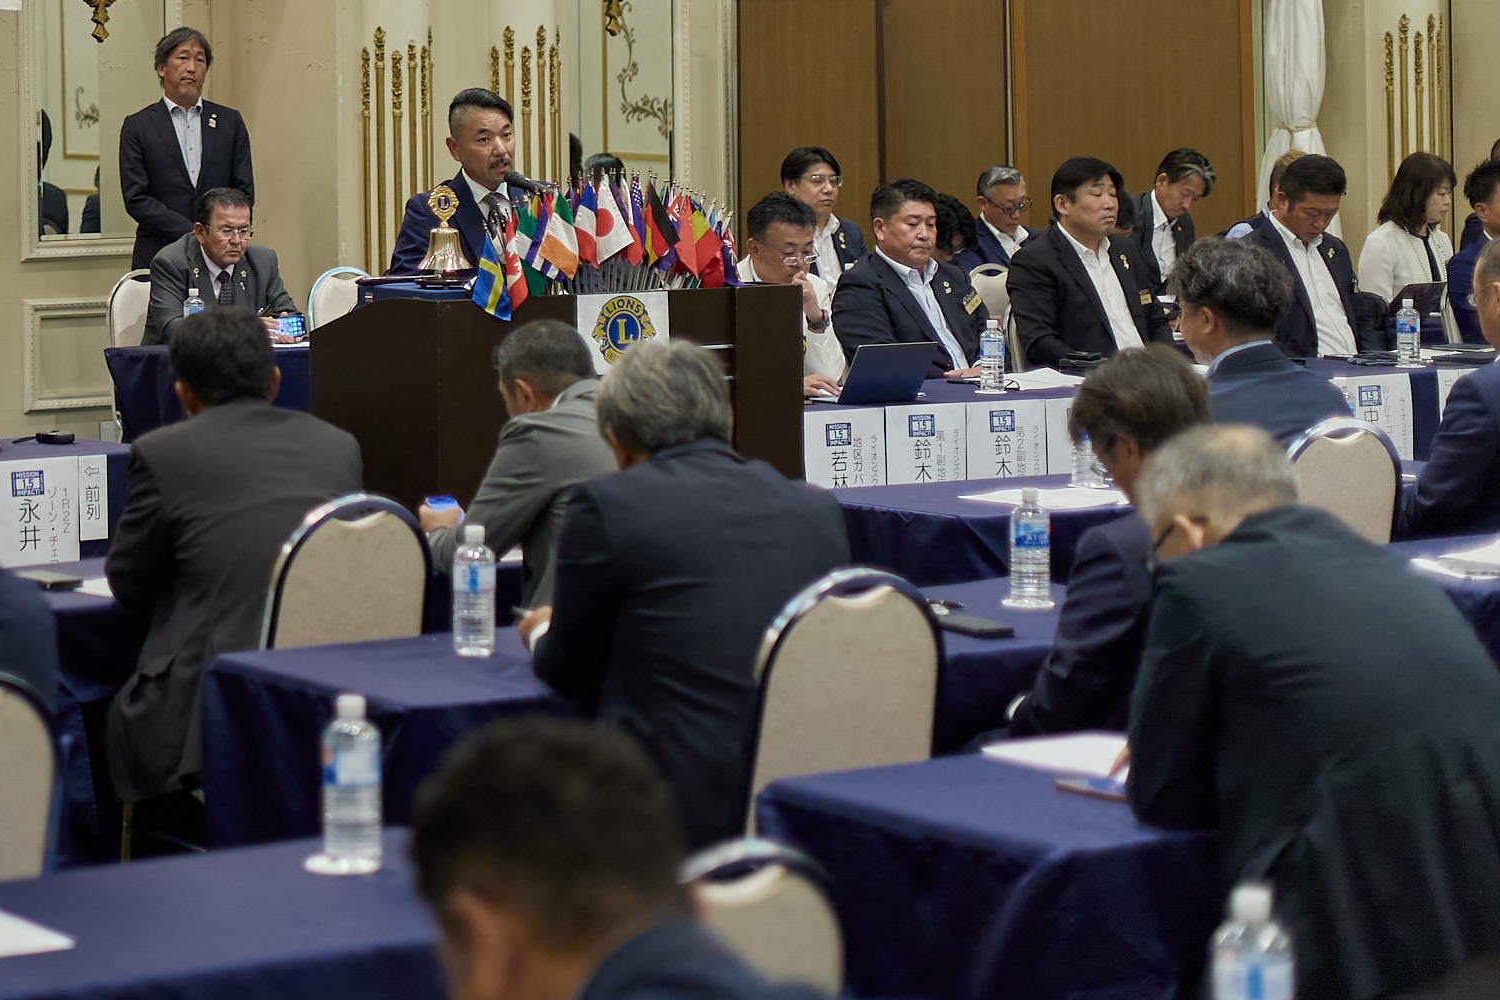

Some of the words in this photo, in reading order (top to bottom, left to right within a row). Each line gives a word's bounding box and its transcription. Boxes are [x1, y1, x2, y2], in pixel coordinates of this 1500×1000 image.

[605, 298, 642, 314] LIONS
[617, 318, 634, 344] L
[1365, 392, 1375, 400] 1.5
[833, 430, 844, 439] 1.5
[917, 421, 927, 430] 1.5
[997, 417, 1007, 426] 1.5
[914, 439, 932, 483] 鈴木
[936, 430, 946, 482] 第1副地
[995, 435, 1012, 478] 鈴木
[1016, 426, 1026, 477] 第2副地
[15, 471, 40, 479] MISSION
[22, 479, 34, 489] 1.5
[62, 487, 70, 534] 1R2Z
[85, 485, 100, 520] 前列
[19, 498, 41, 551] 永井
